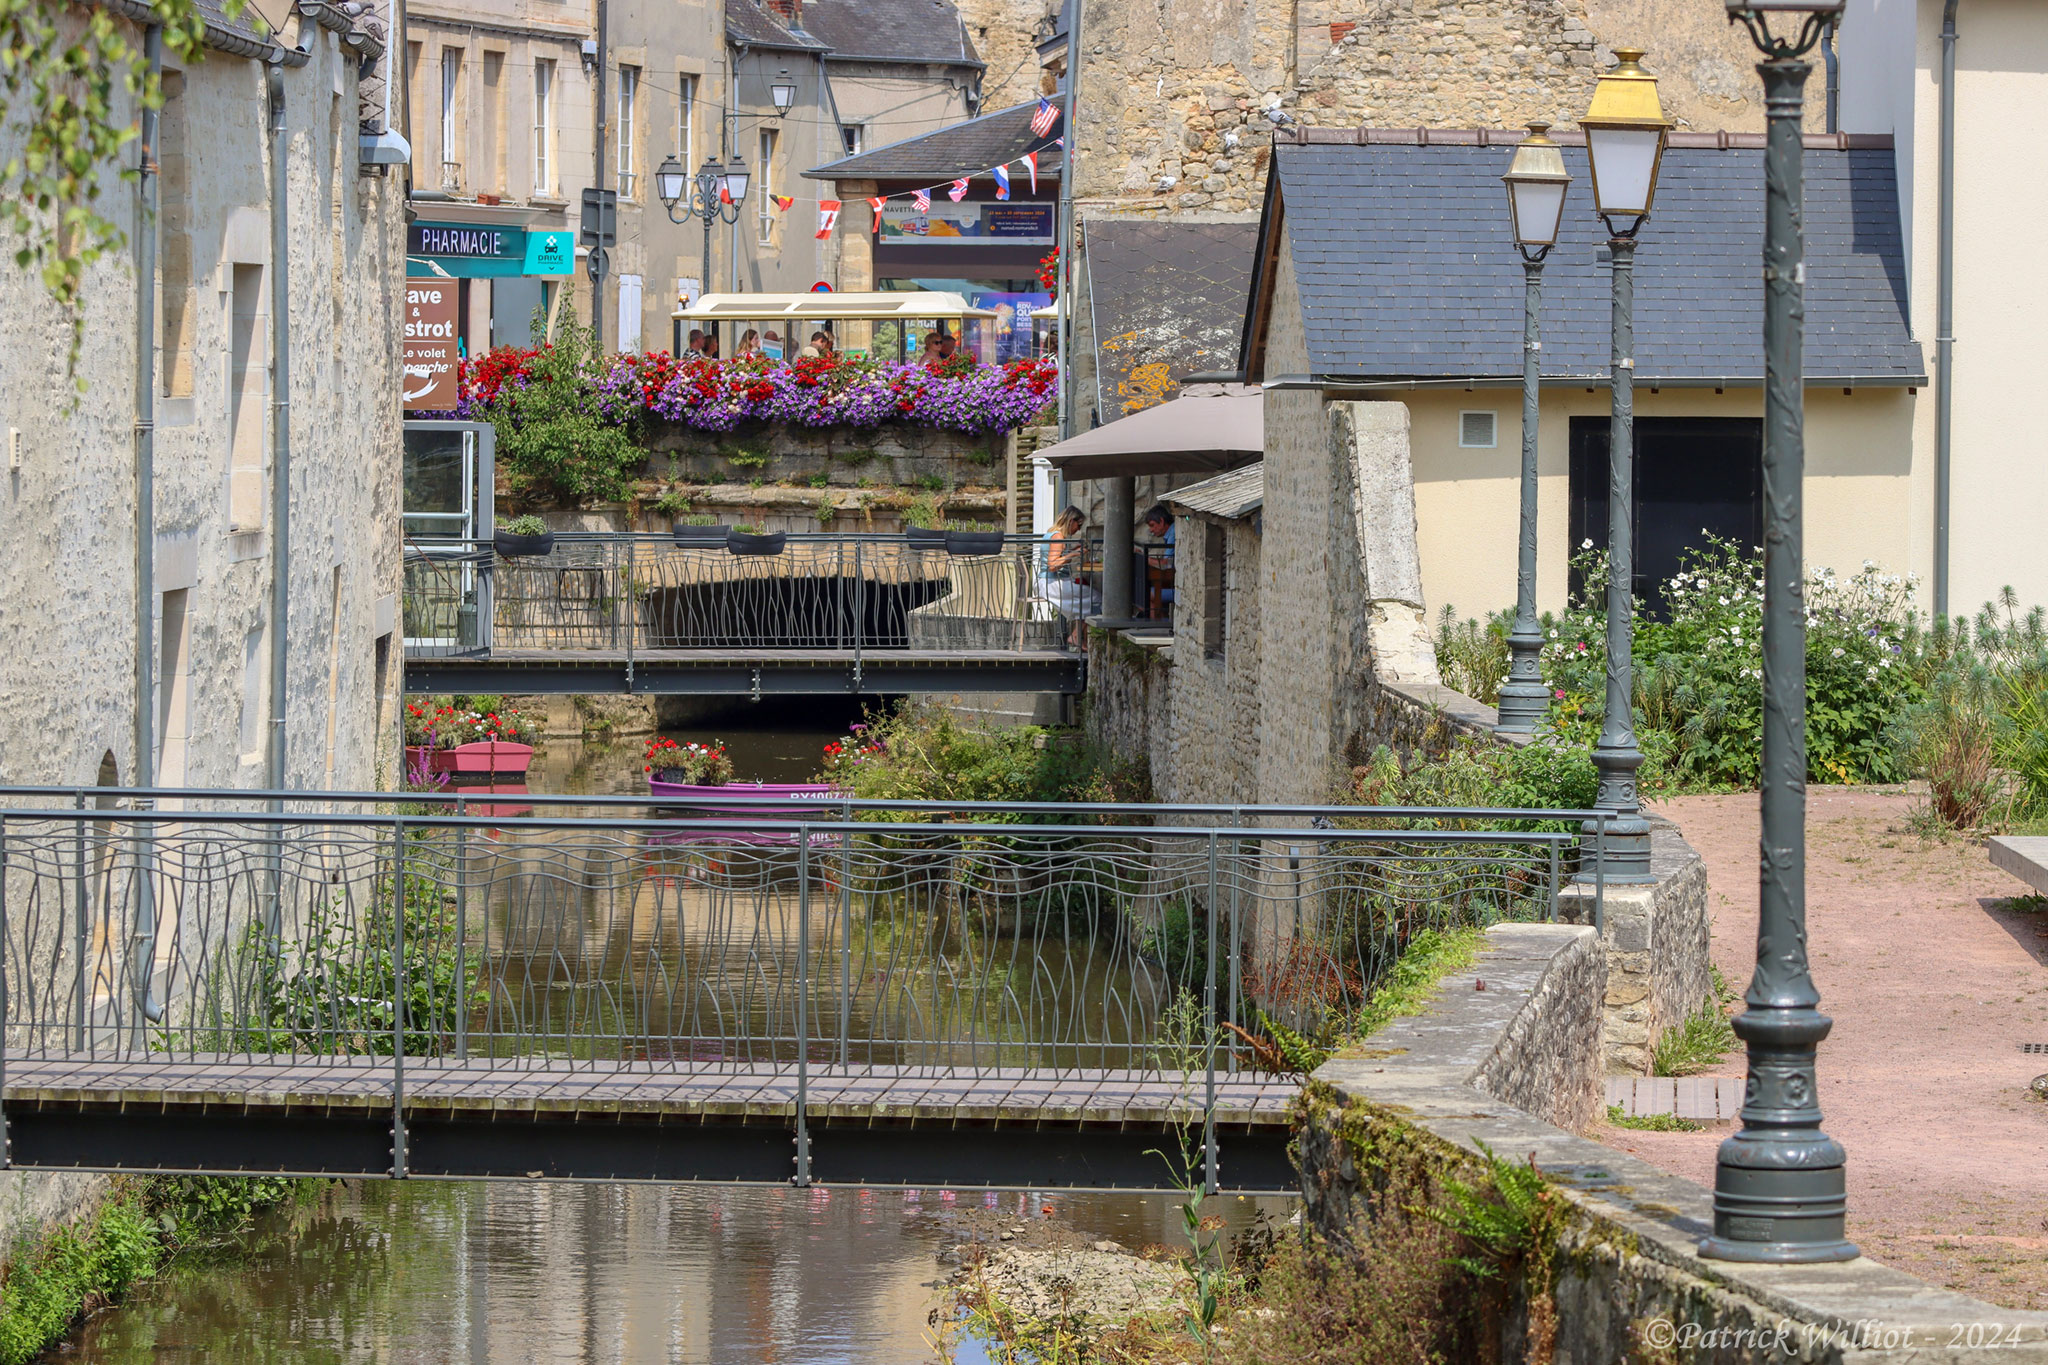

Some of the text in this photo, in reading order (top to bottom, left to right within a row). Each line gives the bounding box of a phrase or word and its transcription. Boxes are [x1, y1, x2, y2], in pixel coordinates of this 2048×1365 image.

[422, 228, 501, 254] PHARMACIE
[405, 289, 442, 304] ave
[412, 306, 420, 317] &
[405, 319, 452, 337] strot
[417, 348, 446, 358] volet
